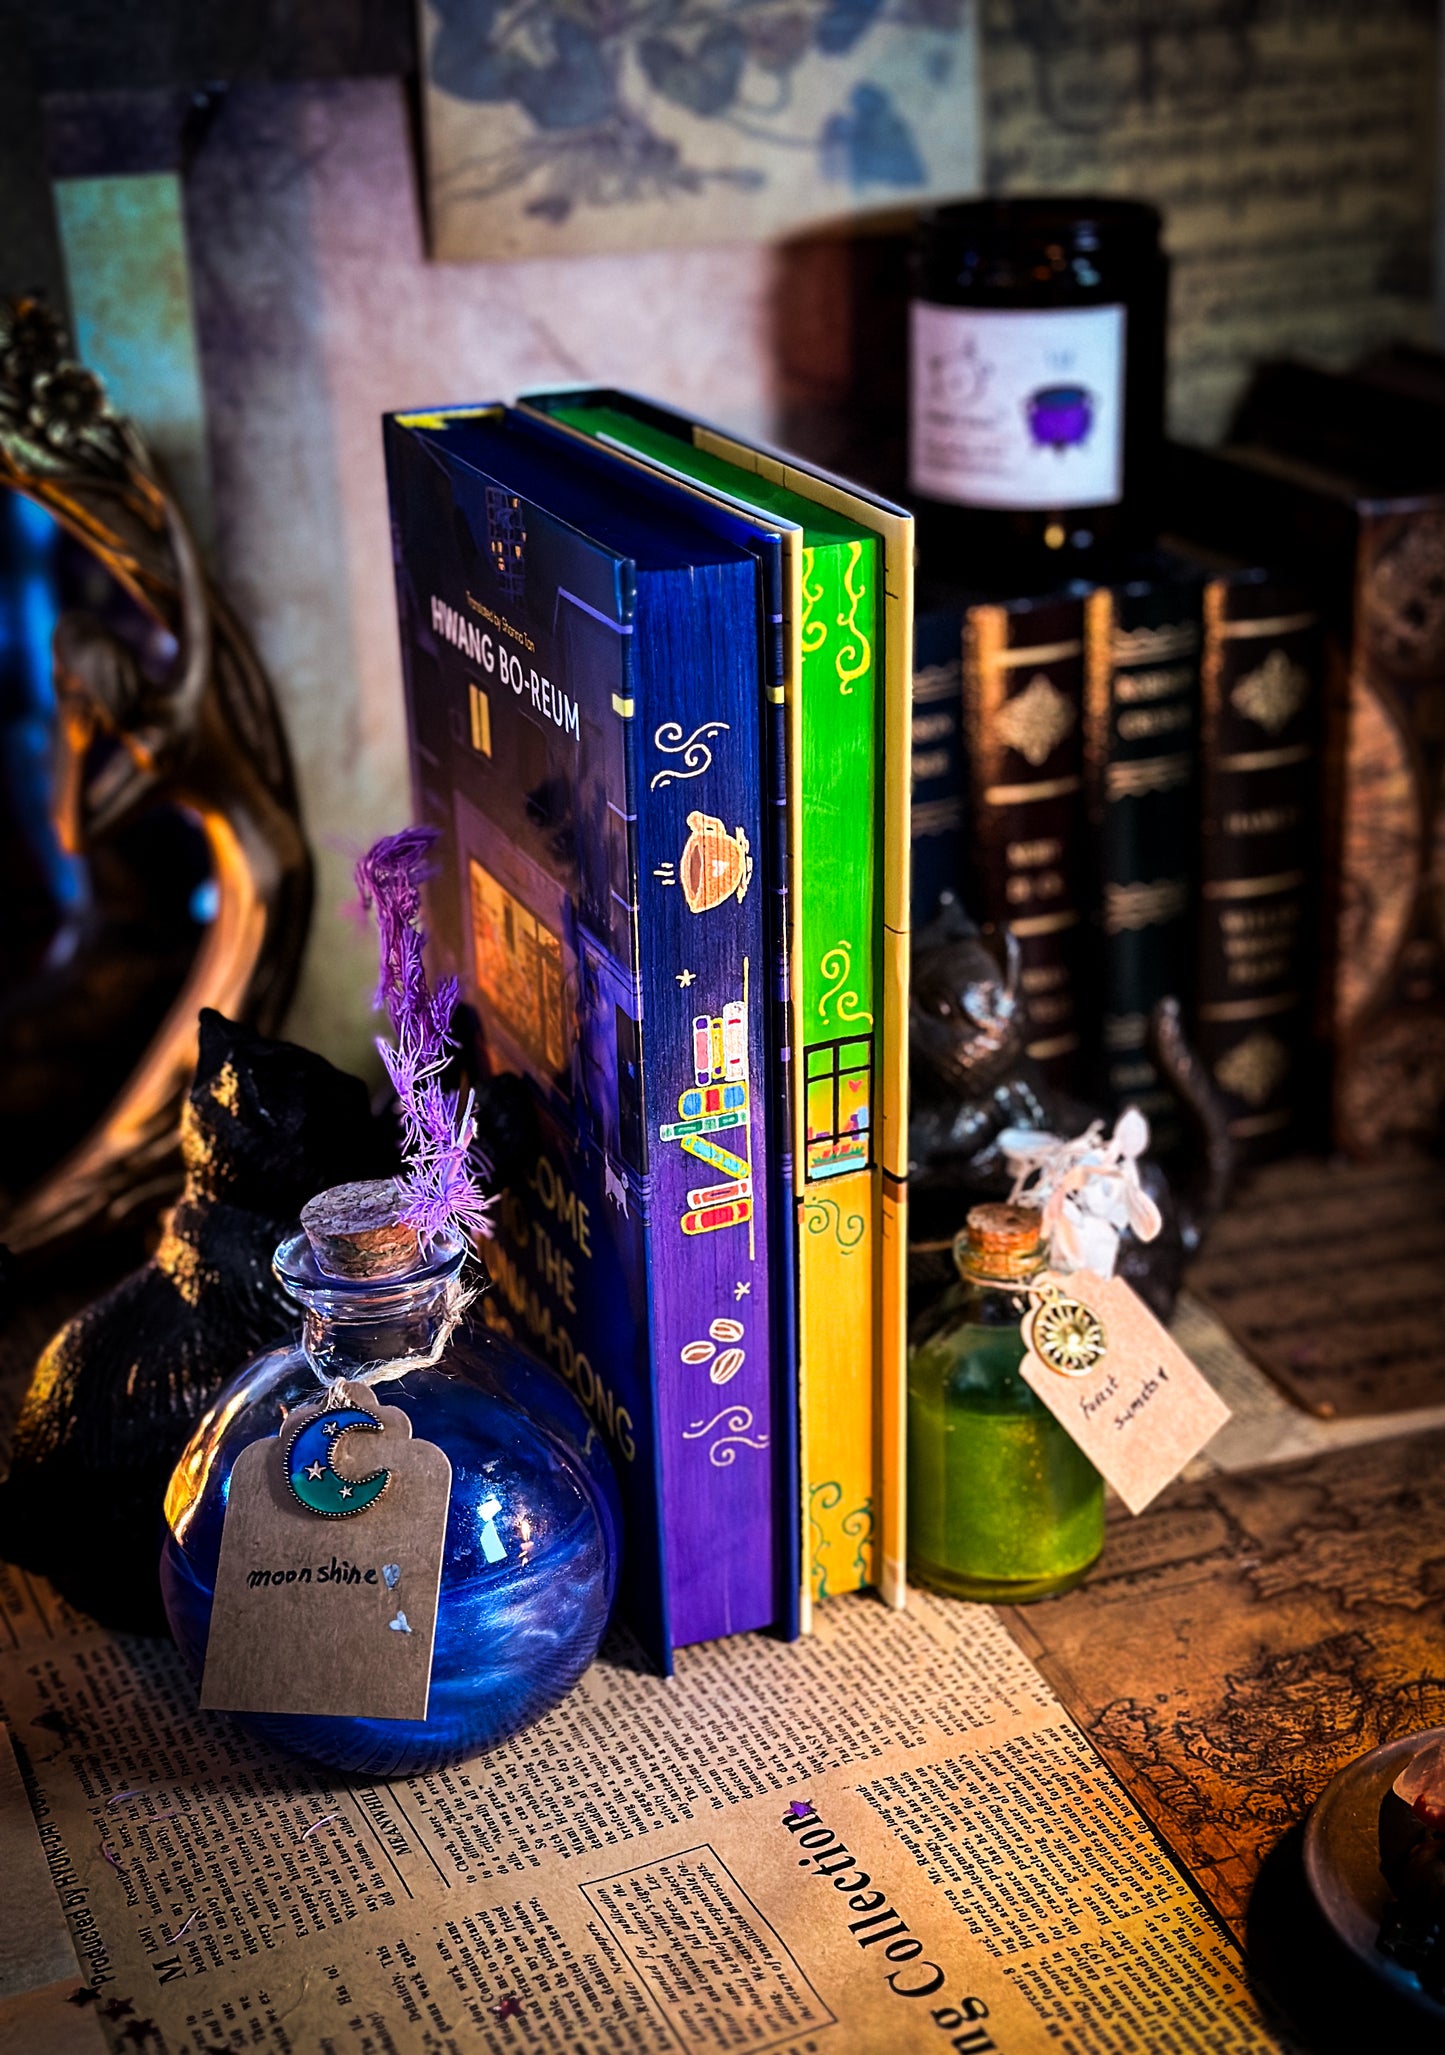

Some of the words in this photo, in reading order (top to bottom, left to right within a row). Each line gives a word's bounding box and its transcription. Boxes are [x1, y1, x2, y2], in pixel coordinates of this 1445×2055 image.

[431, 594, 495, 673] HWANG
[499, 645, 581, 741] BO-REUM
[526, 1155, 592, 1259] OME
[533, 1219, 577, 1315] THE
[520, 1733, 533, 1745] the
[541, 1738, 560, 1757] Dick
[505, 1764, 519, 1779] why
[537, 1759, 556, 1773] job
[556, 1759, 570, 1772] day
[1062, 1746, 1092, 1774] makers
[523, 1762, 544, 1787] racing
[547, 1775, 565, 1793] best
[567, 1775, 580, 1788] the
[900, 1771, 922, 1792] basis
[413, 1791, 427, 1806] was
[870, 1780, 900, 1802] white
[882, 1776, 910, 1798] relied
[918, 1792, 934, 1805] the
[922, 1778, 950, 1802] relied
[1092, 1777, 1134, 1818] horoscope
[253, 1801, 269, 1819] have
[517, 1783, 550, 1819] probably
[540, 1790, 568, 1826] Herald's
[562, 1795, 576, 1808] the
[855, 1784, 899, 1828] long-stand-
[893, 1805, 909, 1818] the
[905, 1799, 923, 1814] has
[944, 1802, 964, 1816] not
[959, 1796, 976, 1809] for
[201, 1806, 217, 1828] horse
[240, 1812, 254, 1826] few
[584, 1801, 608, 1828] middle
[935, 1812, 959, 1833] what
[959, 1816, 978, 1832] has
[212, 1828, 225, 1843] the
[276, 1810, 305, 1847] positions
[428, 1816, 448, 1839] where
[572, 1811, 604, 1849] definitely
[604, 1831, 619, 1845] the
[902, 1819, 924, 1835] and
[926, 1824, 948, 1842] that
[247, 1828, 268, 1851] select
[269, 1832, 285, 1849] ever
[548, 1833, 572, 1859] which
[561, 1827, 588, 1855] Miami
[893, 1827, 931, 1867] Reagan's
[973, 1810, 1032, 1871] pseudoscience
[262, 1854, 276, 1869] the
[297, 1848, 312, 1863] the
[332, 1838, 353, 1865] known
[444, 1840, 469, 1872] Church,
[923, 1838, 962, 1883] astrology,
[953, 1837, 1002, 1882] purposes,
[982, 1846, 1005, 1865] that
[223, 1856, 242, 1878] went
[280, 1852, 302, 1884] history
[303, 1865, 324, 1887] held
[346, 1865, 363, 1882] was
[927, 1867, 946, 1885] Mr.
[612, 1883, 628, 1898] the
[630, 1878, 652, 1903] signa-
[644, 1873, 666, 1893] Let-
[663, 1875, 693, 1906] subject
[943, 1842, 1010, 1918] acknowledgment
[63, 1886, 90, 1910] by
[278, 1884, 292, 1902] one
[364, 1894, 379, 1912] say,
[686, 1874, 727, 1925] responsible
[943, 1889, 972, 1915] given
[995, 1882, 1019, 1906] some
[1004, 1870, 1054, 1922] confidence
[1023, 1873, 1064, 1914] crackpot
[296, 1884, 326, 1931] newspaper
[317, 1889, 343, 1925] neously
[596, 1888, 639, 1935] publication
[662, 1897, 691, 1930] address.
[782, 1812, 946, 1998] Collection
[1013, 1908, 1033, 1922] for
[284, 1904, 310, 1939] Evans,
[644, 1904, 674, 1937] writer's
[689, 1910, 707, 1924] are
[962, 1916, 984, 1935] But
[969, 1900, 1005, 1937] interest
[1060, 1917, 1082, 1935] this
[138, 1926, 159, 1955] IAMI
[256, 1924, 276, 1949] every
[669, 1936, 685, 1951] the
[683, 1933, 709, 1950] full
[697, 1925, 718, 1941] and
[729, 1914, 773, 1960] unsolicited
[1005, 1919, 1035, 1950] House
[1047, 1925, 1067, 1940] for
[66, 1907, 116, 1987] Producted
[585, 1921, 627, 1974] Newspapers.
[634, 1945, 655, 1960] for
[708, 1942, 734, 1963] brief
[728, 1935, 757, 1965] cannot
[1000, 1937, 1019, 1955] ing
[655, 1953, 696, 1996] addressed
[680, 1951, 709, 1984] contain
[701, 1959, 724, 1975] and
[644, 1965, 681, 2003] intended
[699, 1985, 722, 2003] and
[721, 1982, 745, 2007] name
[735, 1977, 767, 2010] should
[776, 1973, 804, 2005] return
